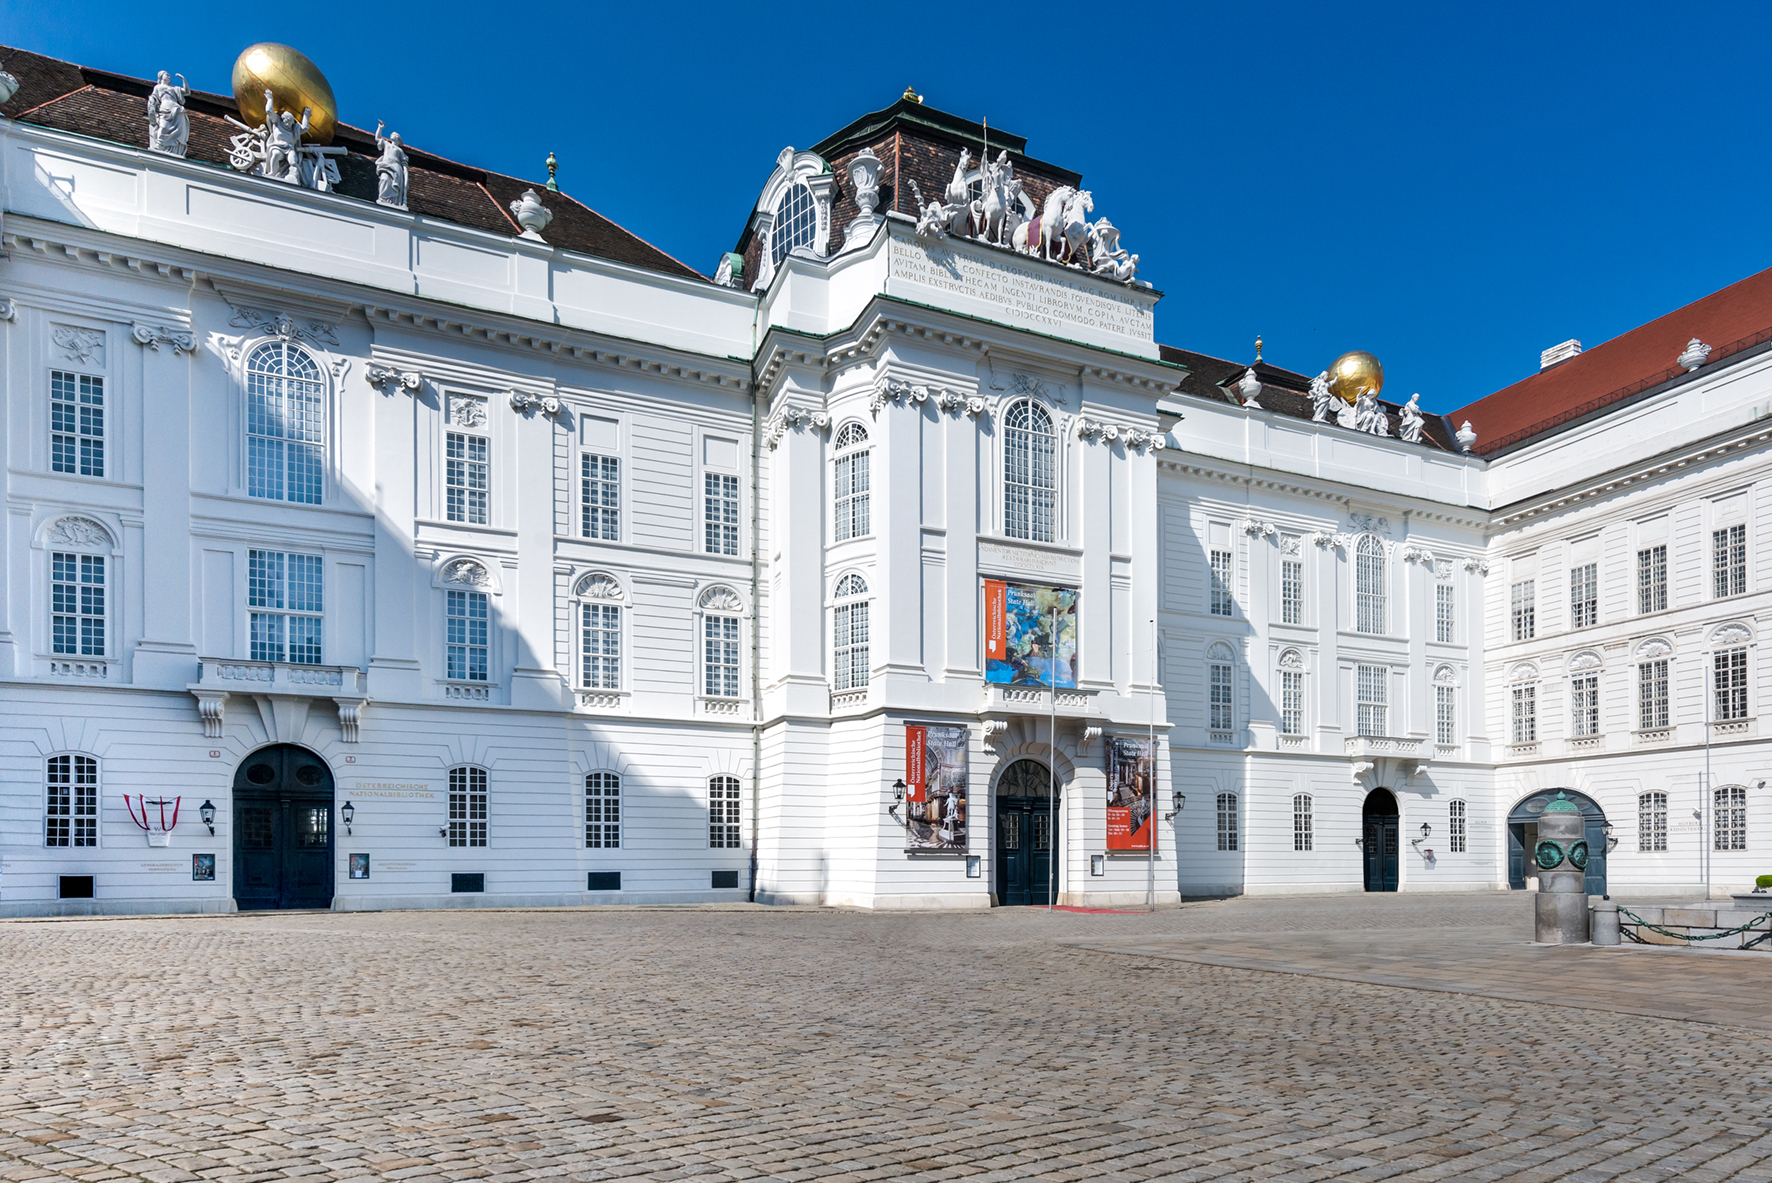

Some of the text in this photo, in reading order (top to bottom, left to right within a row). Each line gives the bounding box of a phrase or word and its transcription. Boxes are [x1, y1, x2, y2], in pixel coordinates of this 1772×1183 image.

[894, 246, 921, 260] BELLO
[963, 265, 1008, 283] CONFECTO
[1012, 278, 1067, 298] INSTAVRANDIS
[1071, 293, 1121, 313] FOVENDISQVE
[894, 258, 1152, 331] AVITAM BIBLIOTHECAM INGENTI LIBRORVM COPIA AVCTAM
[894, 269, 1152, 340] AMPLIS EXSTRVCTIS AEDIBVS PVBLICO COMMODO PATERE IVSSIT
[356, 782, 429, 790] ÖSTERREICHISCHE
